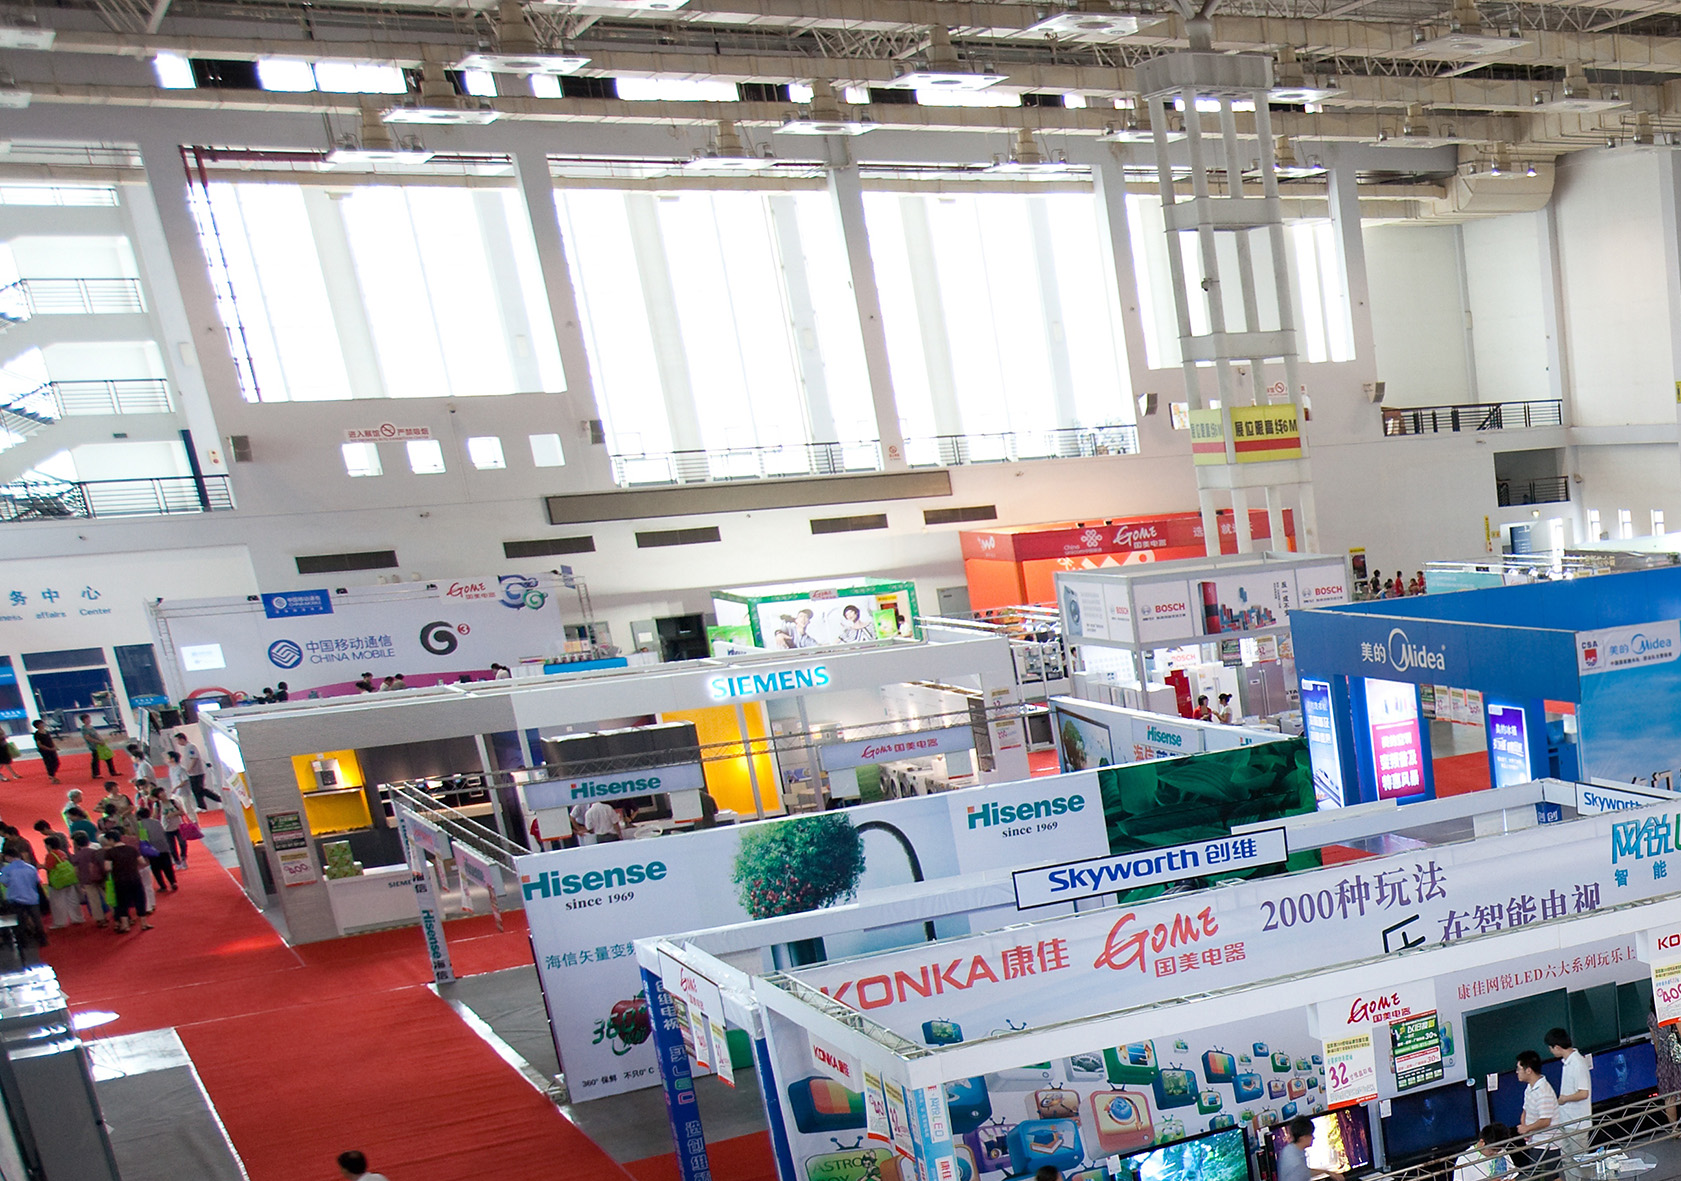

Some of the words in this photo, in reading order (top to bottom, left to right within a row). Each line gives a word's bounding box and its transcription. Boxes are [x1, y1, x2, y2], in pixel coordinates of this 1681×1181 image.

[1134, 539, 1167, 549] 国美电器
[1314, 585, 1343, 596] BOSCH
[36, 611, 67, 619] affairs
[79, 607, 112, 616] Center
[1116, 606, 1129, 615] BOSCH
[1155, 602, 1186, 614] BOSCH
[306, 634, 393, 654] 中国移动通信
[1361, 641, 1386, 664] 美的
[1388, 628, 1445, 672] Midea
[1581, 641, 1598, 649] CSA
[1610, 643, 1629, 655] 美的
[1631, 633, 1672, 654] Midea
[310, 653, 349, 665] CHINA
[352, 648, 396, 661] MOBILE
[711, 666, 829, 699] SIEMENS
[894, 737, 939, 752] 国美电器
[1147, 725, 1182, 747] Hisense
[570, 774, 662, 800] Hisense
[967, 794, 1085, 829] Hisense
[1002, 825, 1032, 838] since
[1036, 821, 1058, 833] 1969
[1049, 849, 1200, 892] Skyworth
[1205, 838, 1257, 864] 创维
[522, 860, 668, 902] Hisense
[565, 895, 604, 911] since
[607, 891, 635, 904] 1969
[1260, 861, 1448, 932] 2000种玩法
[422, 909, 441, 958] Hisense
[1154, 942, 1246, 978] 国美电器
[820, 954, 999, 1012] KONKA
[1002, 938, 1070, 980] 康佳
[1458, 945, 1636, 1001] 康佳网锐LED六大系列玩乐上
[1373, 1005, 1411, 1023] 国美电器
[813, 1045, 838, 1071] KONKA
[1329, 1062, 1349, 1088] 32
[813, 1156, 862, 1173] ASTRO
